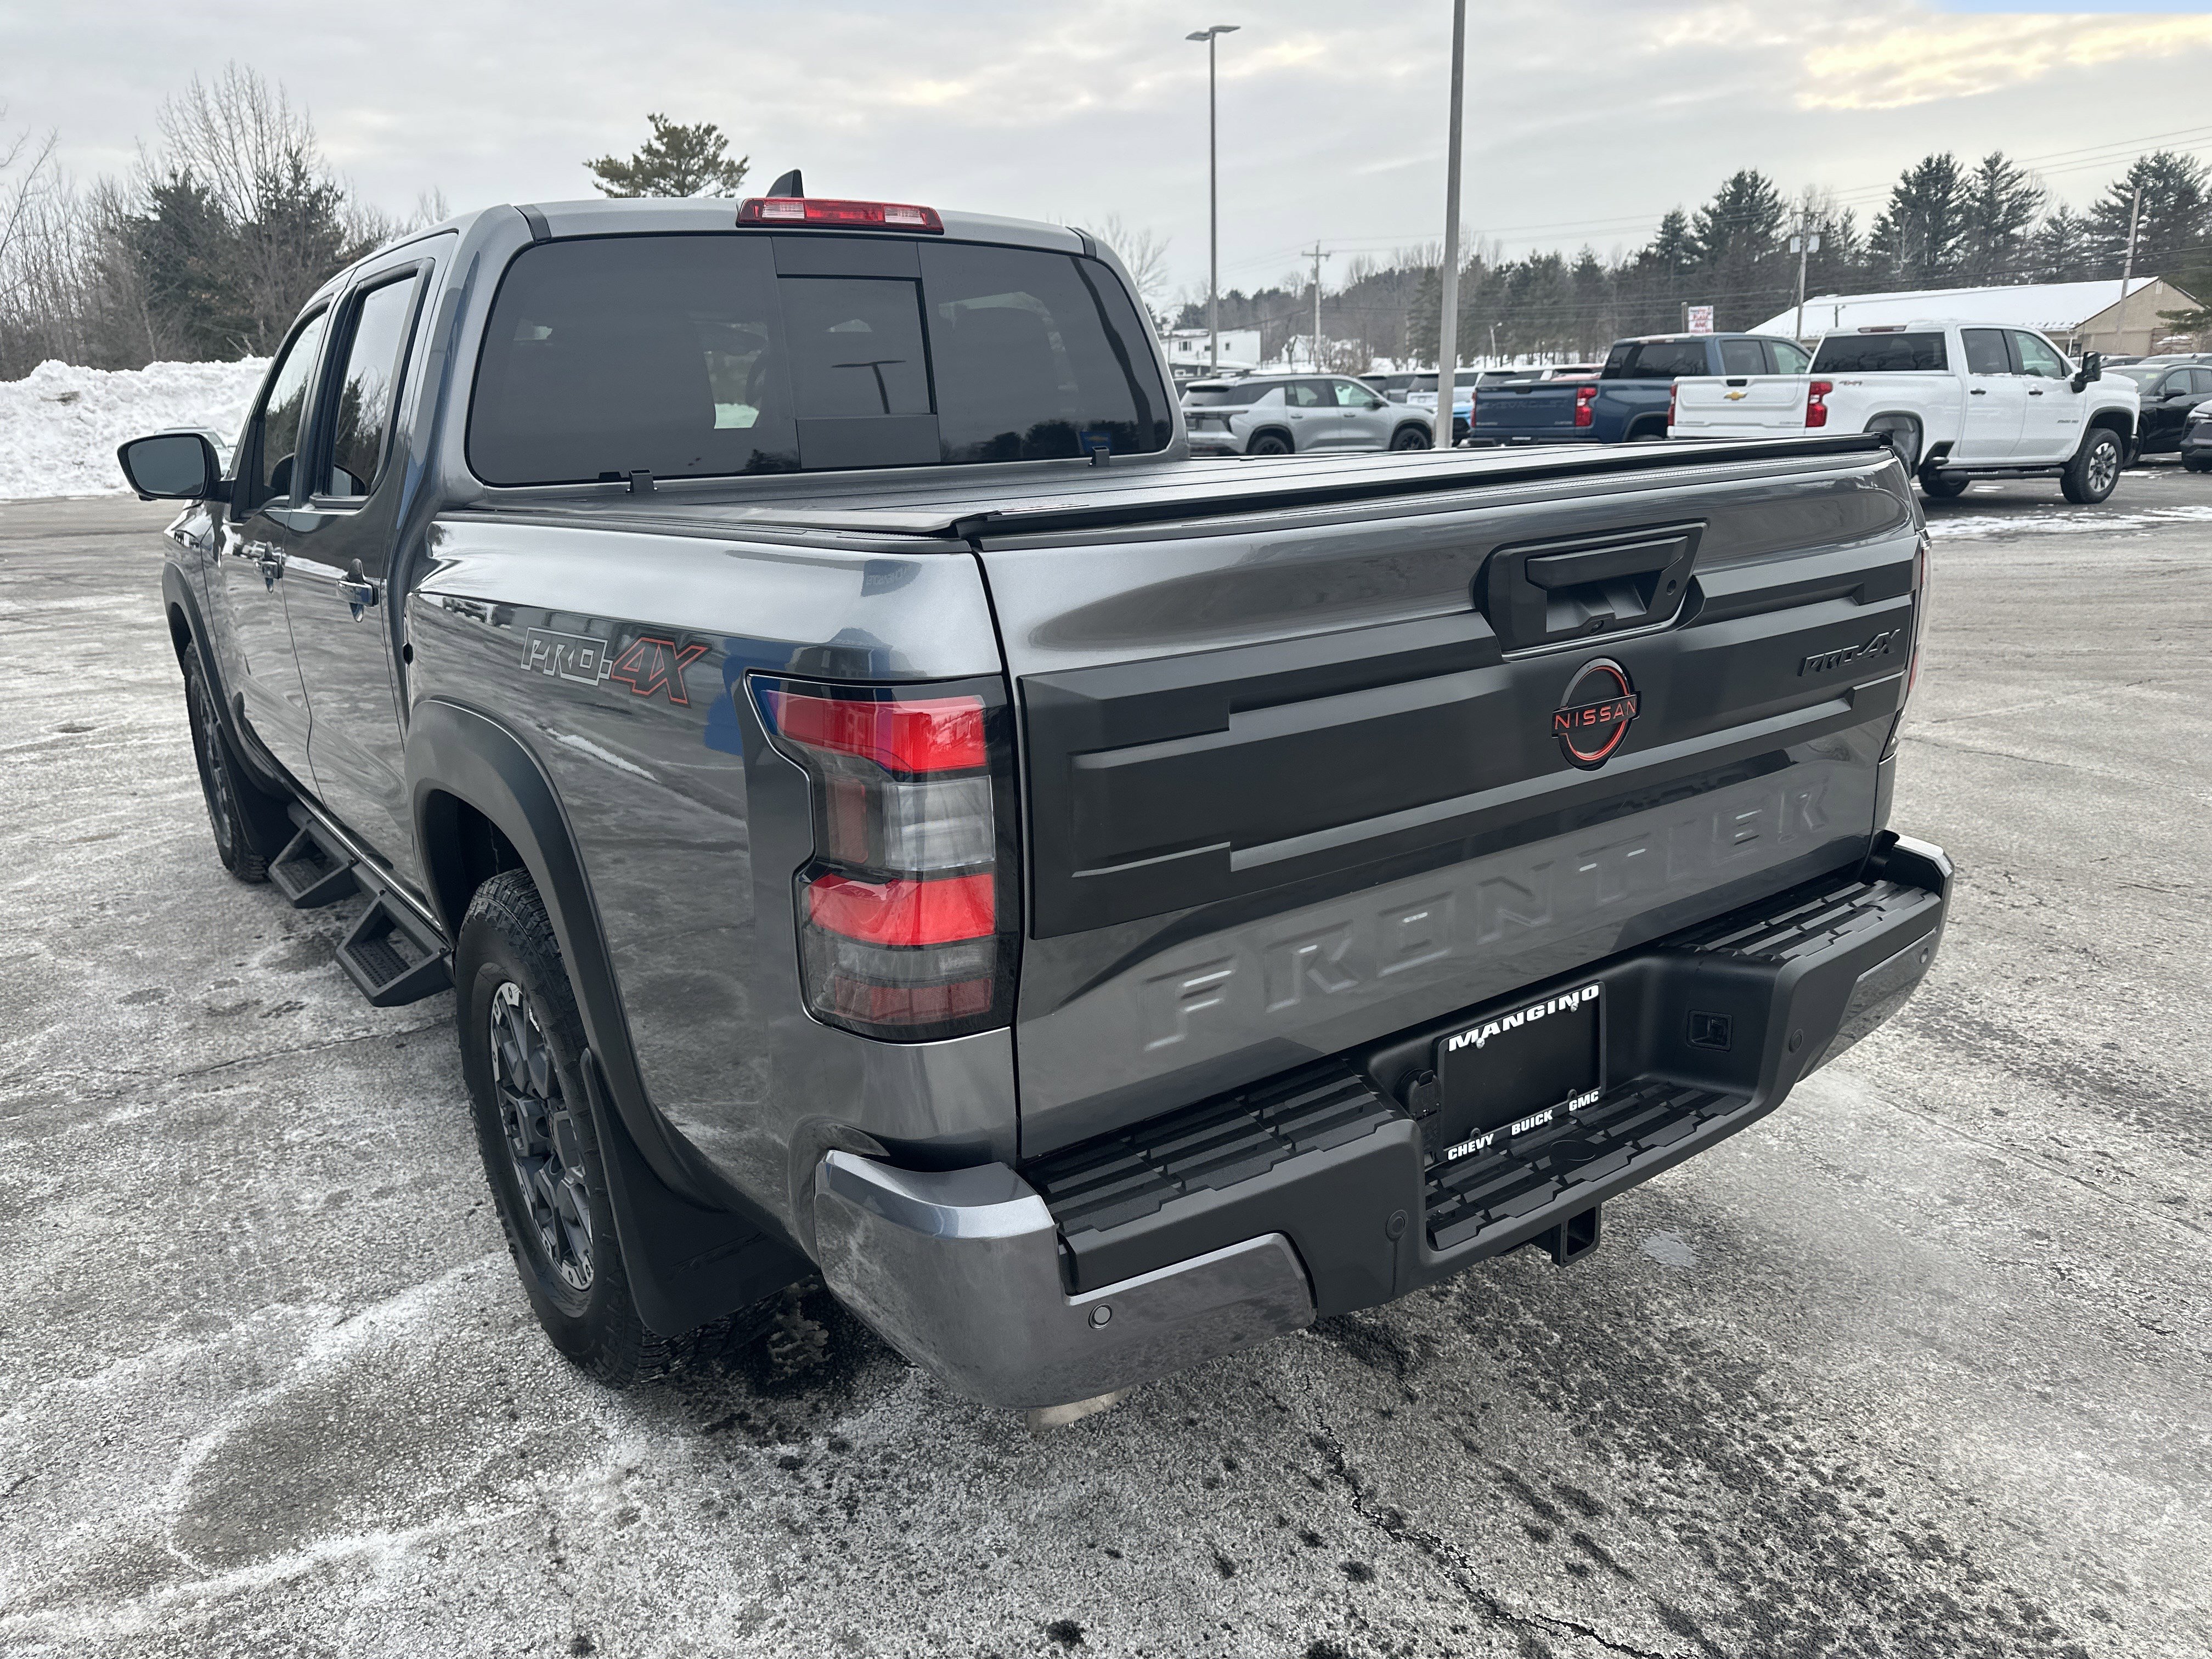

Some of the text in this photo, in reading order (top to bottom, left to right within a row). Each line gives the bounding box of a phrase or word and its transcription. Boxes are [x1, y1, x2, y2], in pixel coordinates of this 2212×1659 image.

[521, 627, 709, 704] PRO-4X
[1797, 628, 1901, 676] PRO-4X
[1554, 698, 1637, 730] NISSAN
[1142, 774, 1830, 1051] FRONTIER
[1448, 985, 1599, 1052] MANGINO
[1448, 1091, 1599, 1160] CHEVY BUICK GMC
